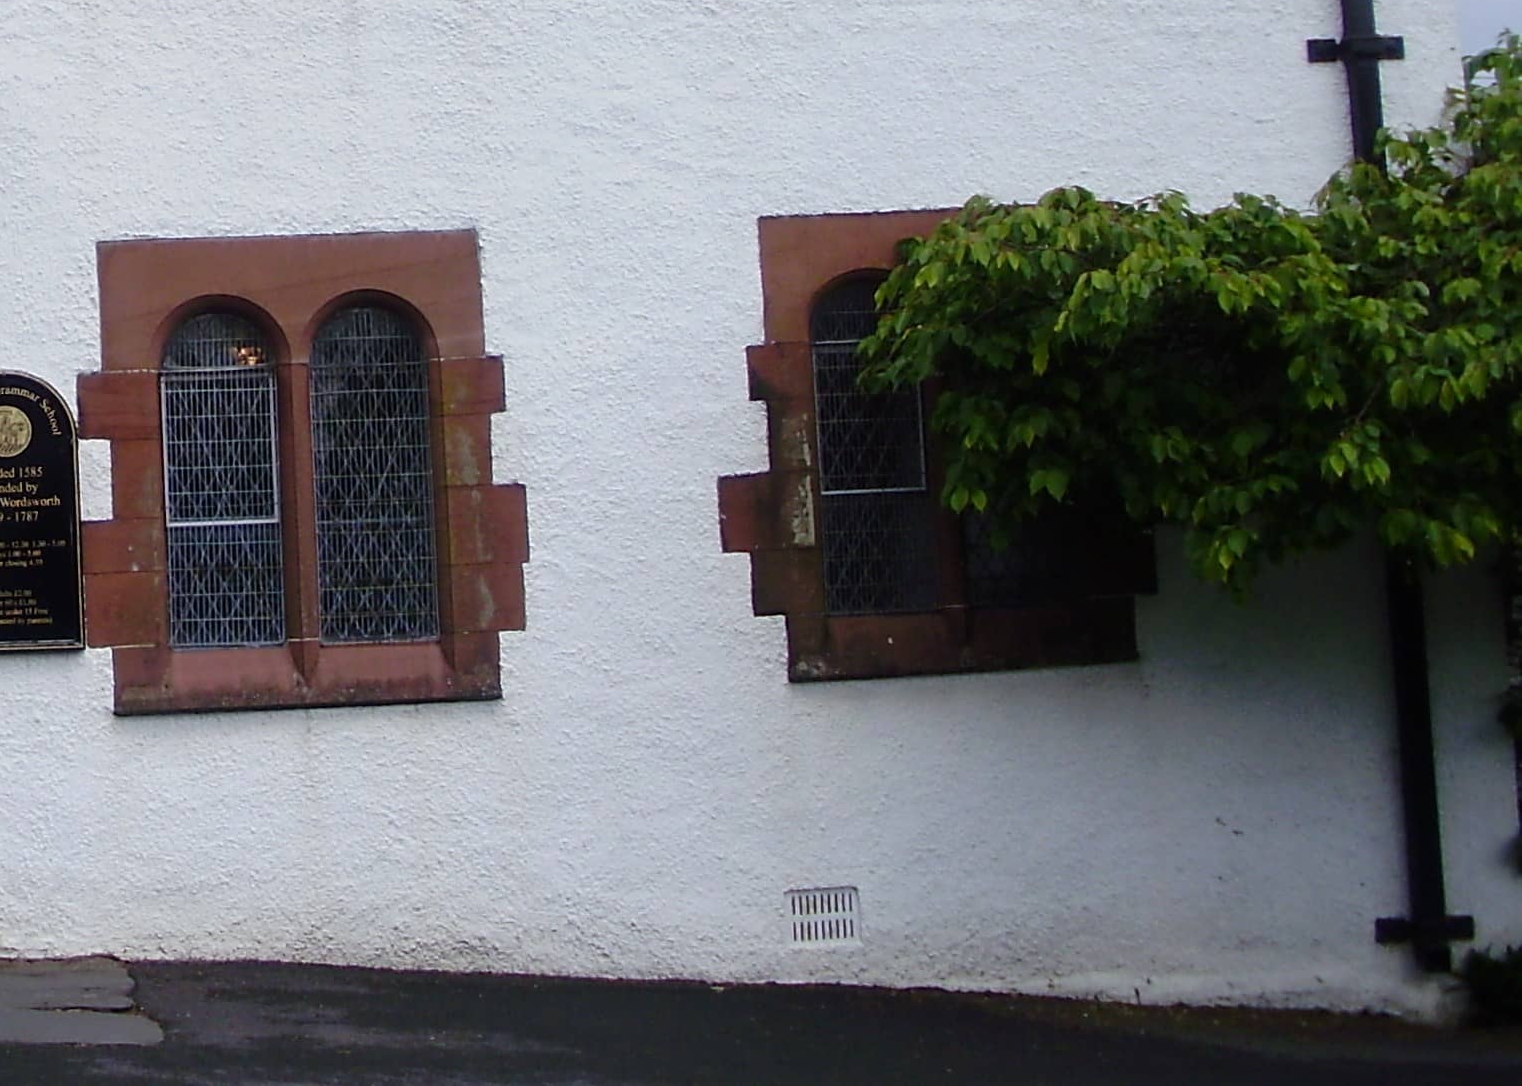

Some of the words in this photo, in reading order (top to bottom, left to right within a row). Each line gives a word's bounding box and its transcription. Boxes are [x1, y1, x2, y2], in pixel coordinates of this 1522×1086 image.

[39, 399, 62, 435] School
[19, 466, 43, 477] 1585
[26, 481, 38, 494] by
[0, 495, 61, 507] Wordsworth
[15, 511, 38, 522] 1787
